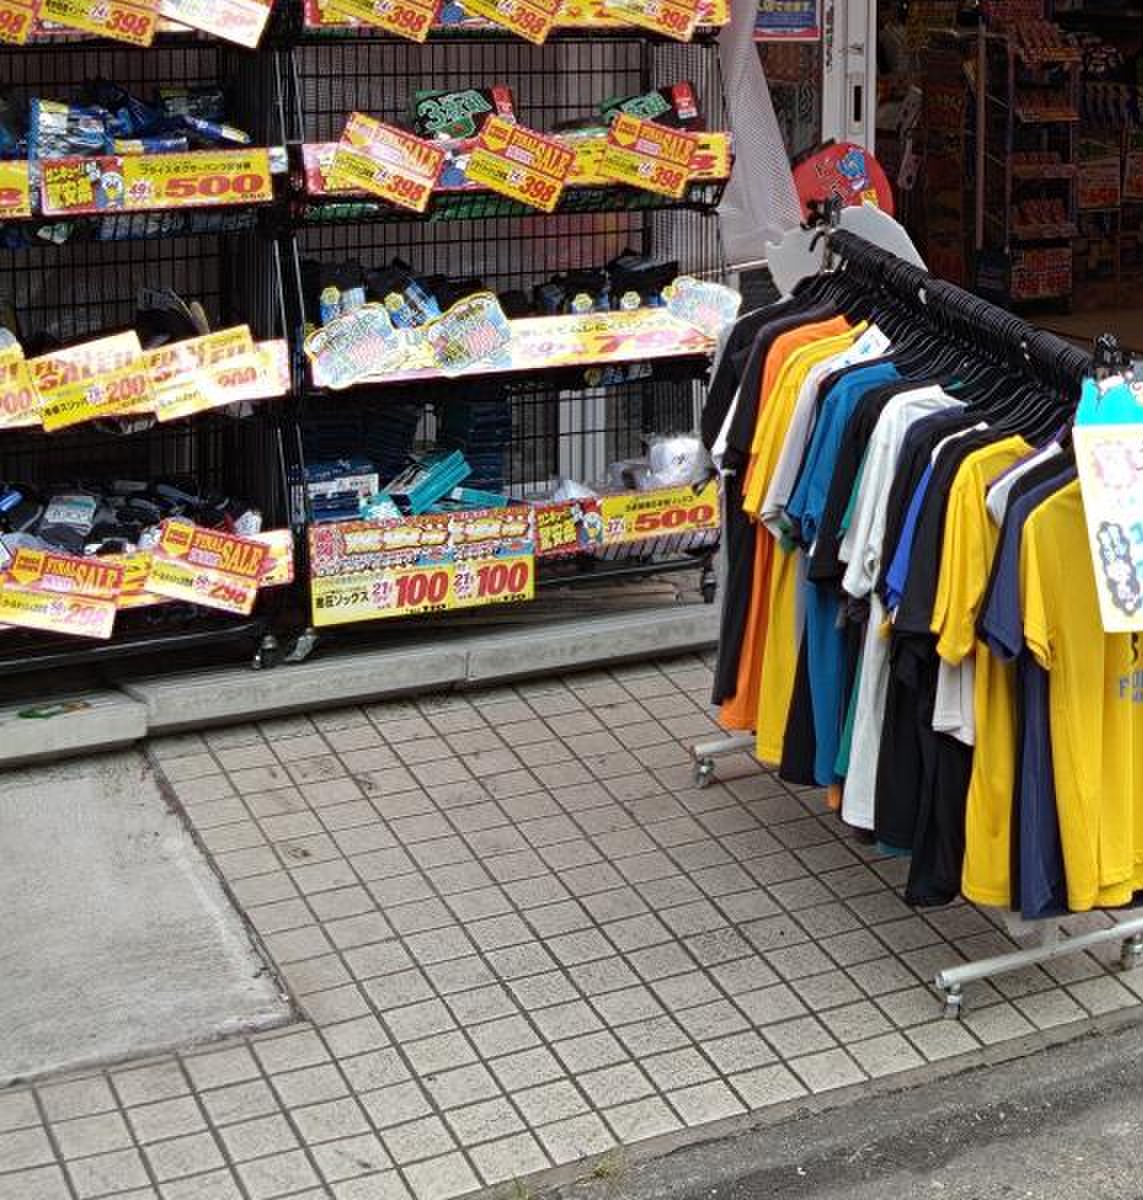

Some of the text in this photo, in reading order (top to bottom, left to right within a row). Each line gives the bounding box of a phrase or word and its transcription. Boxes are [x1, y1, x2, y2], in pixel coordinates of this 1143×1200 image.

[387, 6, 428, 32] 398
[510, 6, 548, 35] 398
[656, 8, 692, 34] 398
[164, 173, 265, 198] 500
[386, 175, 428, 202] 398
[519, 175, 557, 202] 398
[650, 166, 684, 191] 398
[634, 504, 714, 532] 500
[395, 570, 450, 608] 100
[477, 562, 530, 597] 100
